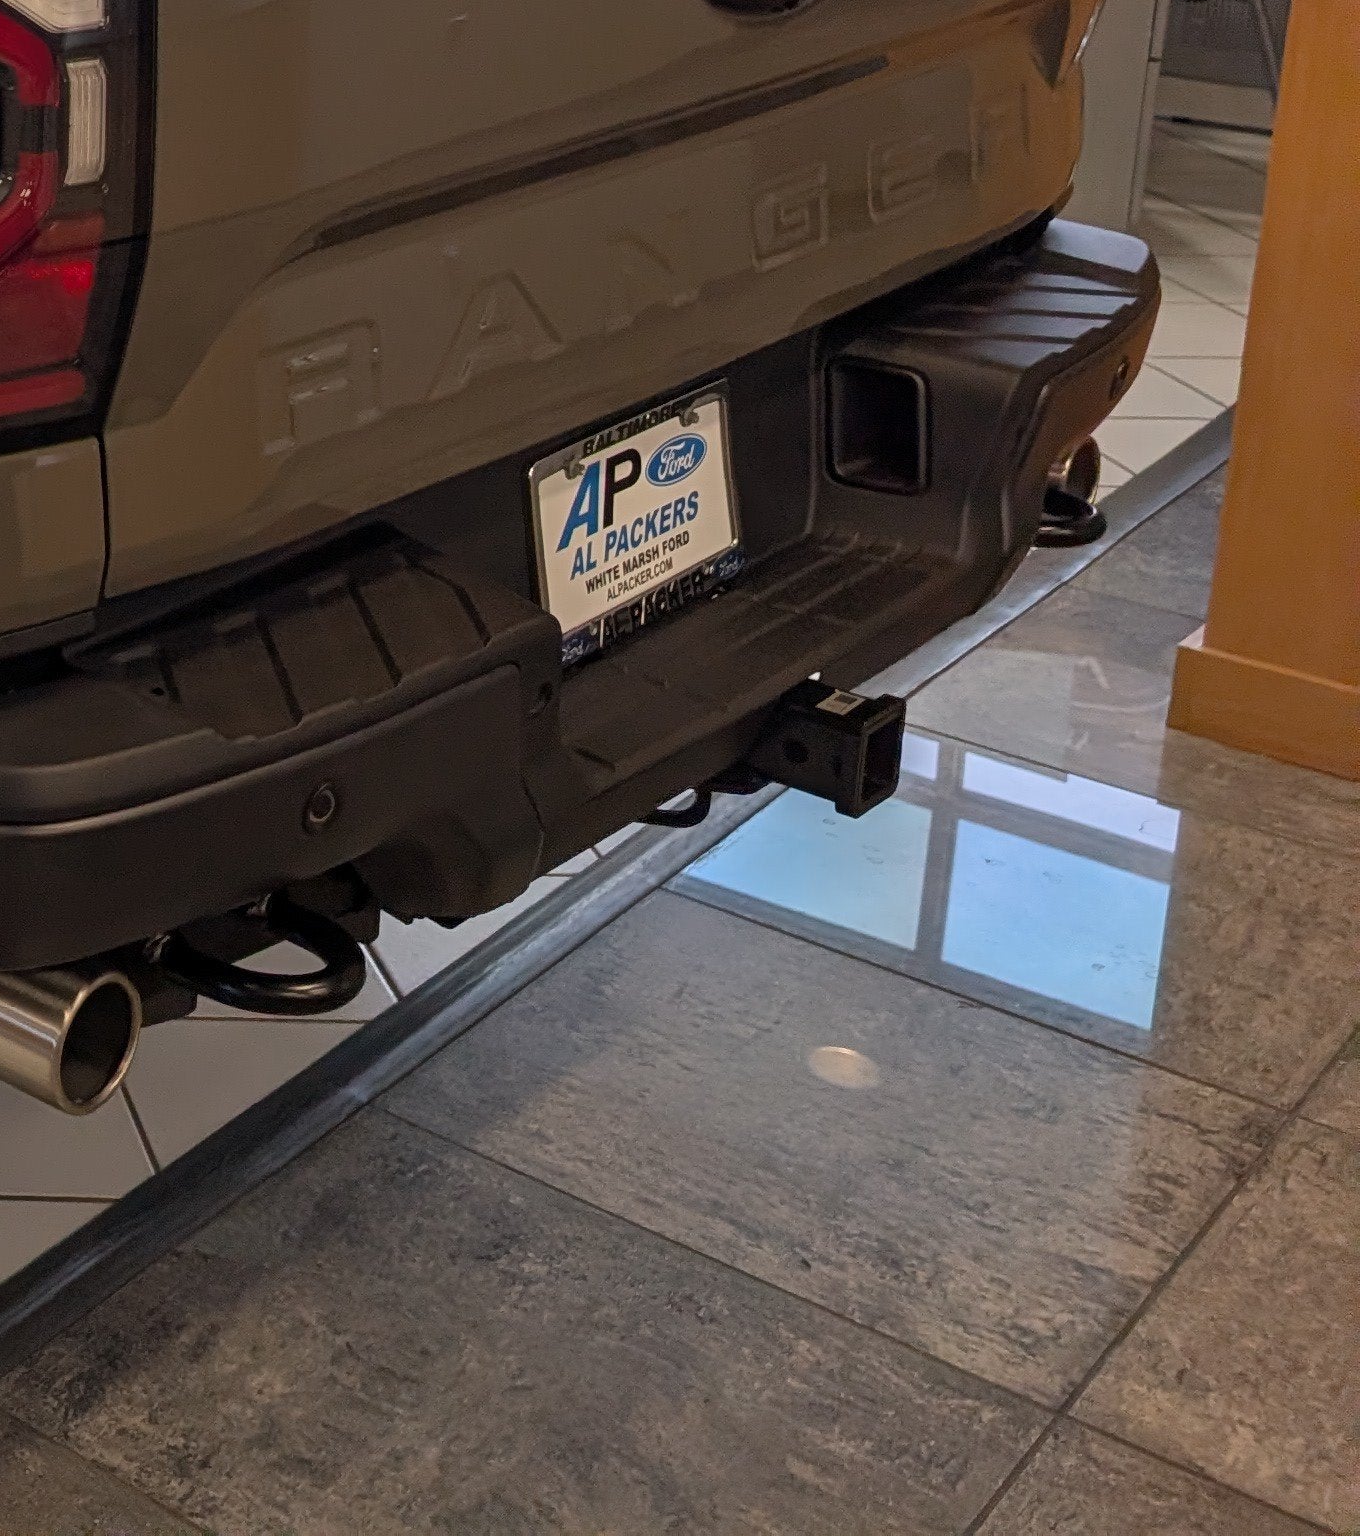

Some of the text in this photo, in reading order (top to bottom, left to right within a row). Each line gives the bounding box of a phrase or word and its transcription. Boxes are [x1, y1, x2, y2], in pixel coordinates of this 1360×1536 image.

[581, 402, 681, 458] BALTIMORE
[554, 439, 696, 554] AP Ford
[569, 490, 700, 581] AL PACKERS
[584, 529, 691, 595] WHITE MARSH FORD
[606, 556, 675, 603] ALPACKER.COM
